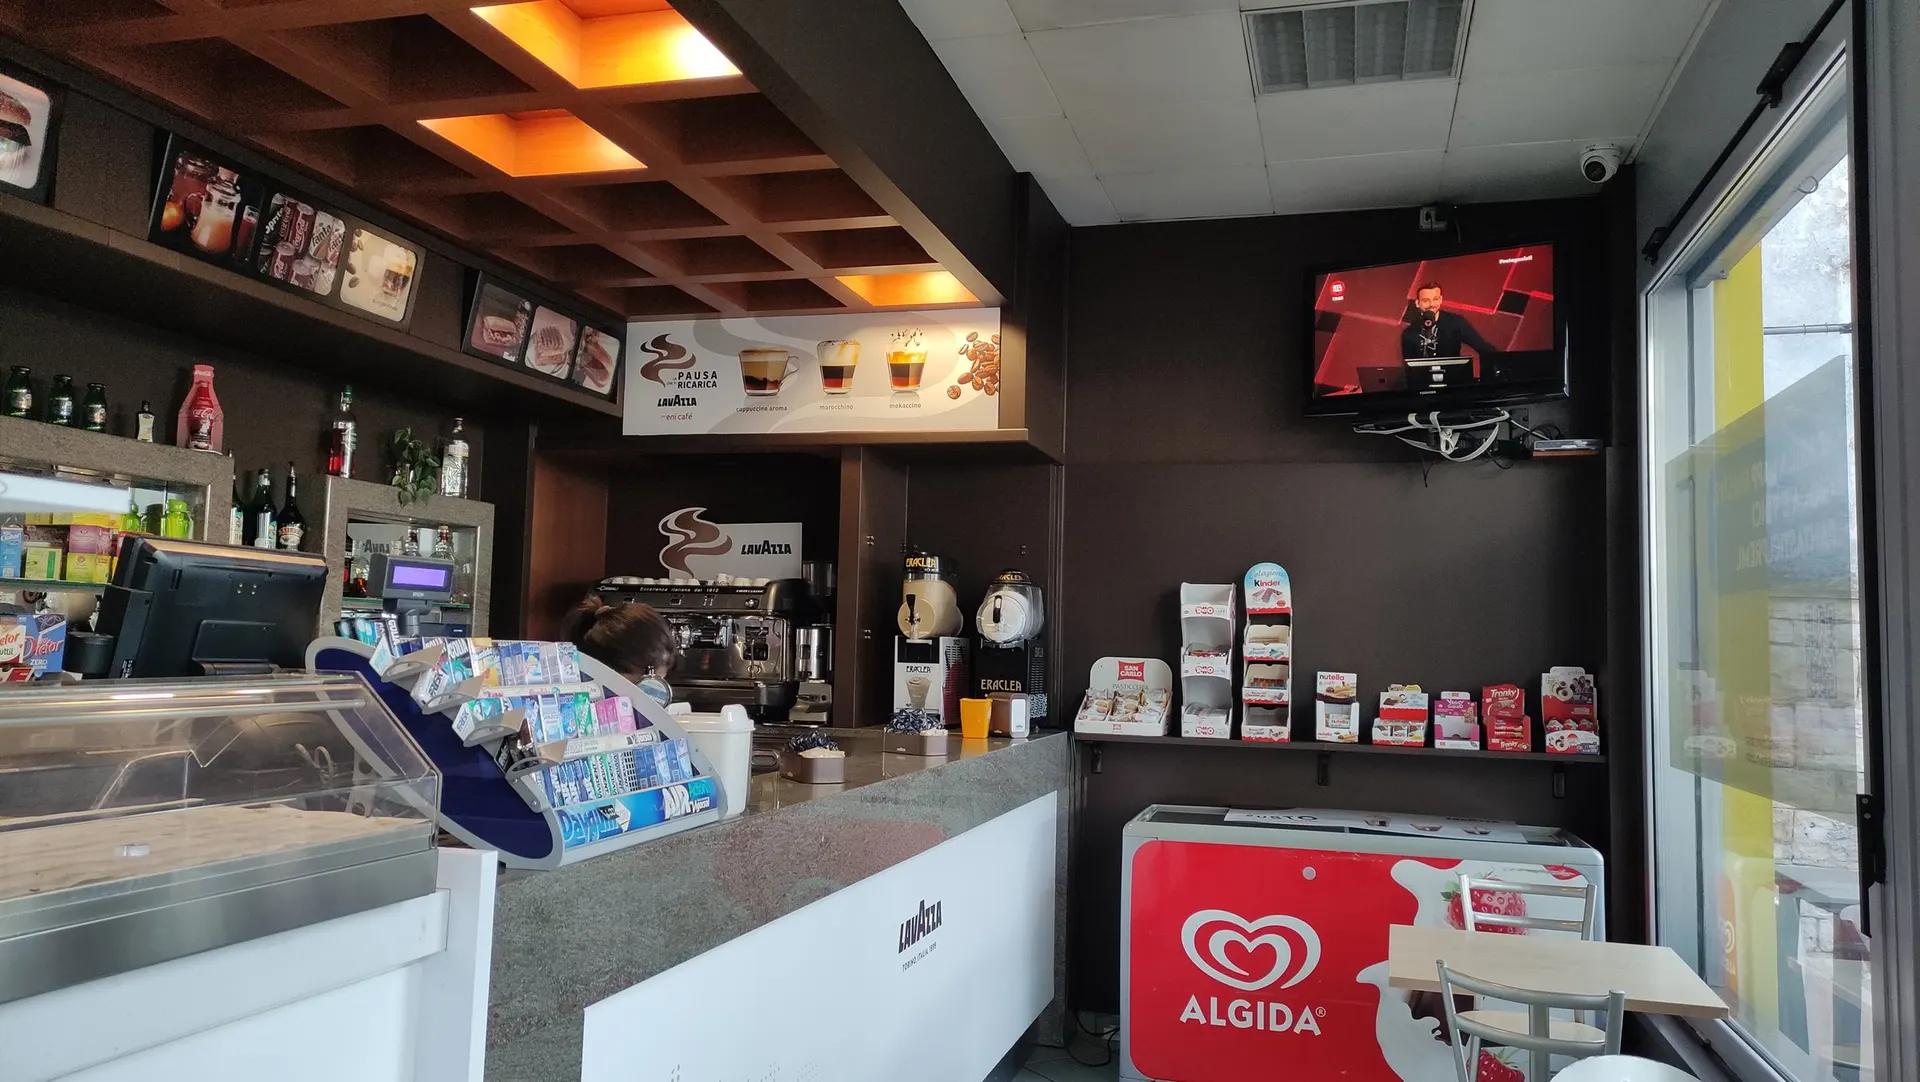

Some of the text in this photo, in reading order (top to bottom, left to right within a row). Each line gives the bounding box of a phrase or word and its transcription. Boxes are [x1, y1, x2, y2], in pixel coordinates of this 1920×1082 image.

[677, 371, 718, 381] PAUSA
[677, 380, 718, 389] RICARICA
[657, 394, 697, 407] LAVAZZA
[666, 412, 693, 421] eni café
[741, 540, 792, 555] LAVAZZA
[22, 635, 64, 658] Dietor
[30, 658, 48, 666] ZERO
[906, 665, 931, 674] ERACLEA
[1319, 673, 1345, 681] nutella
[981, 679, 1022, 692] ERACLEA
[1491, 688, 1517, 698] Tronky
[663, 784, 691, 820] AIR
[898, 899, 942, 954] LAVAZZA
